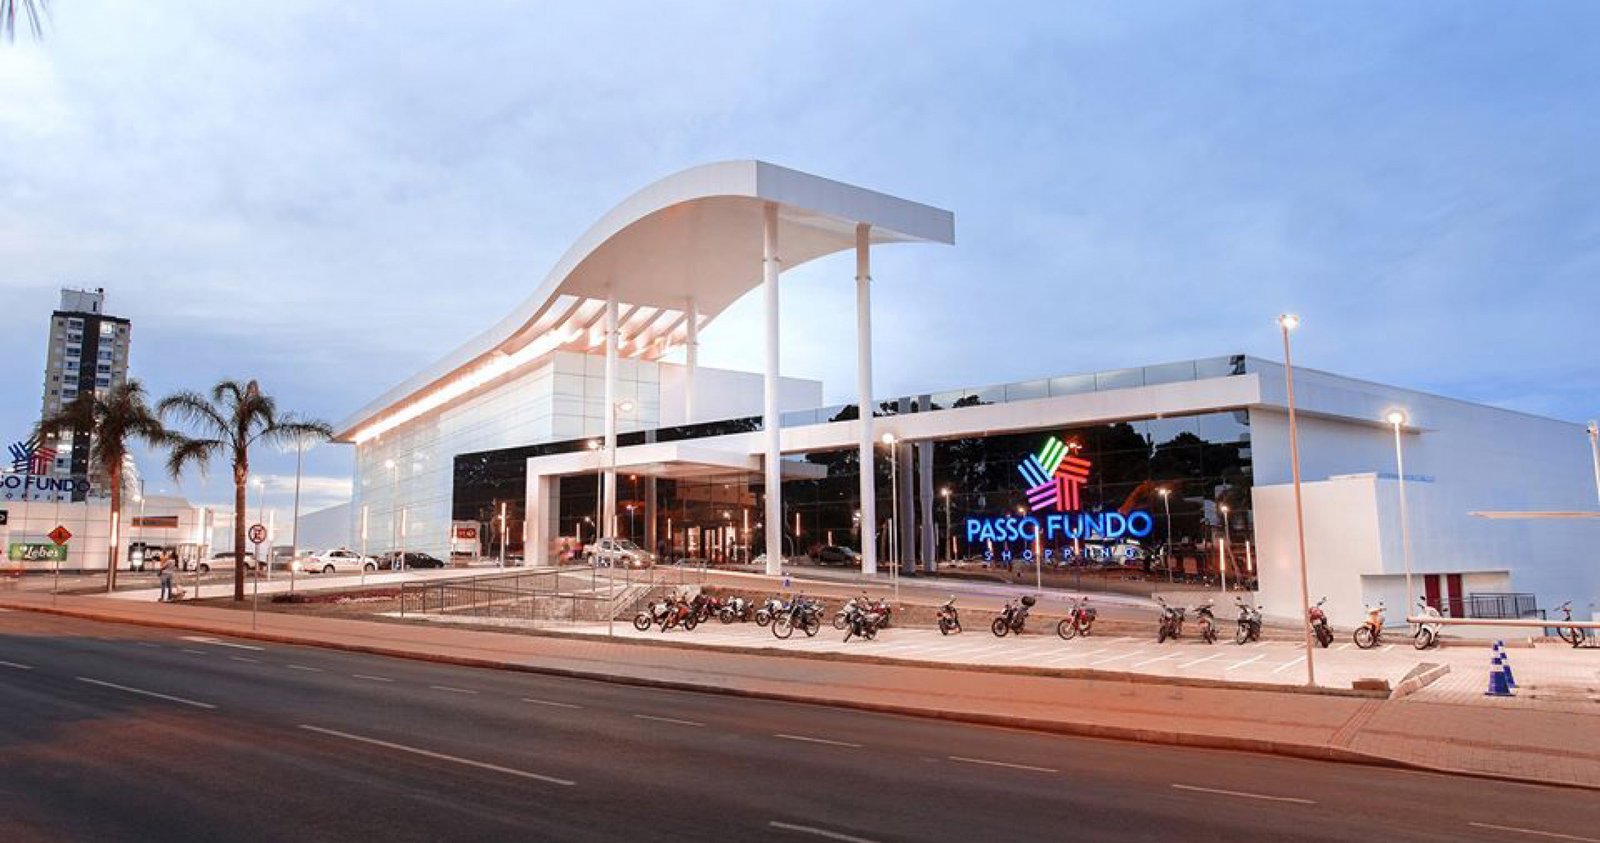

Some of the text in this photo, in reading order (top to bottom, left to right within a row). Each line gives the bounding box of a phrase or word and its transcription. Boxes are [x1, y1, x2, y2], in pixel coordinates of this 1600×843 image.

[25, 475, 91, 492] FUNDO
[967, 511, 1153, 542] PASSO FUNDO
[984, 548, 1137, 561] SHOPPING
